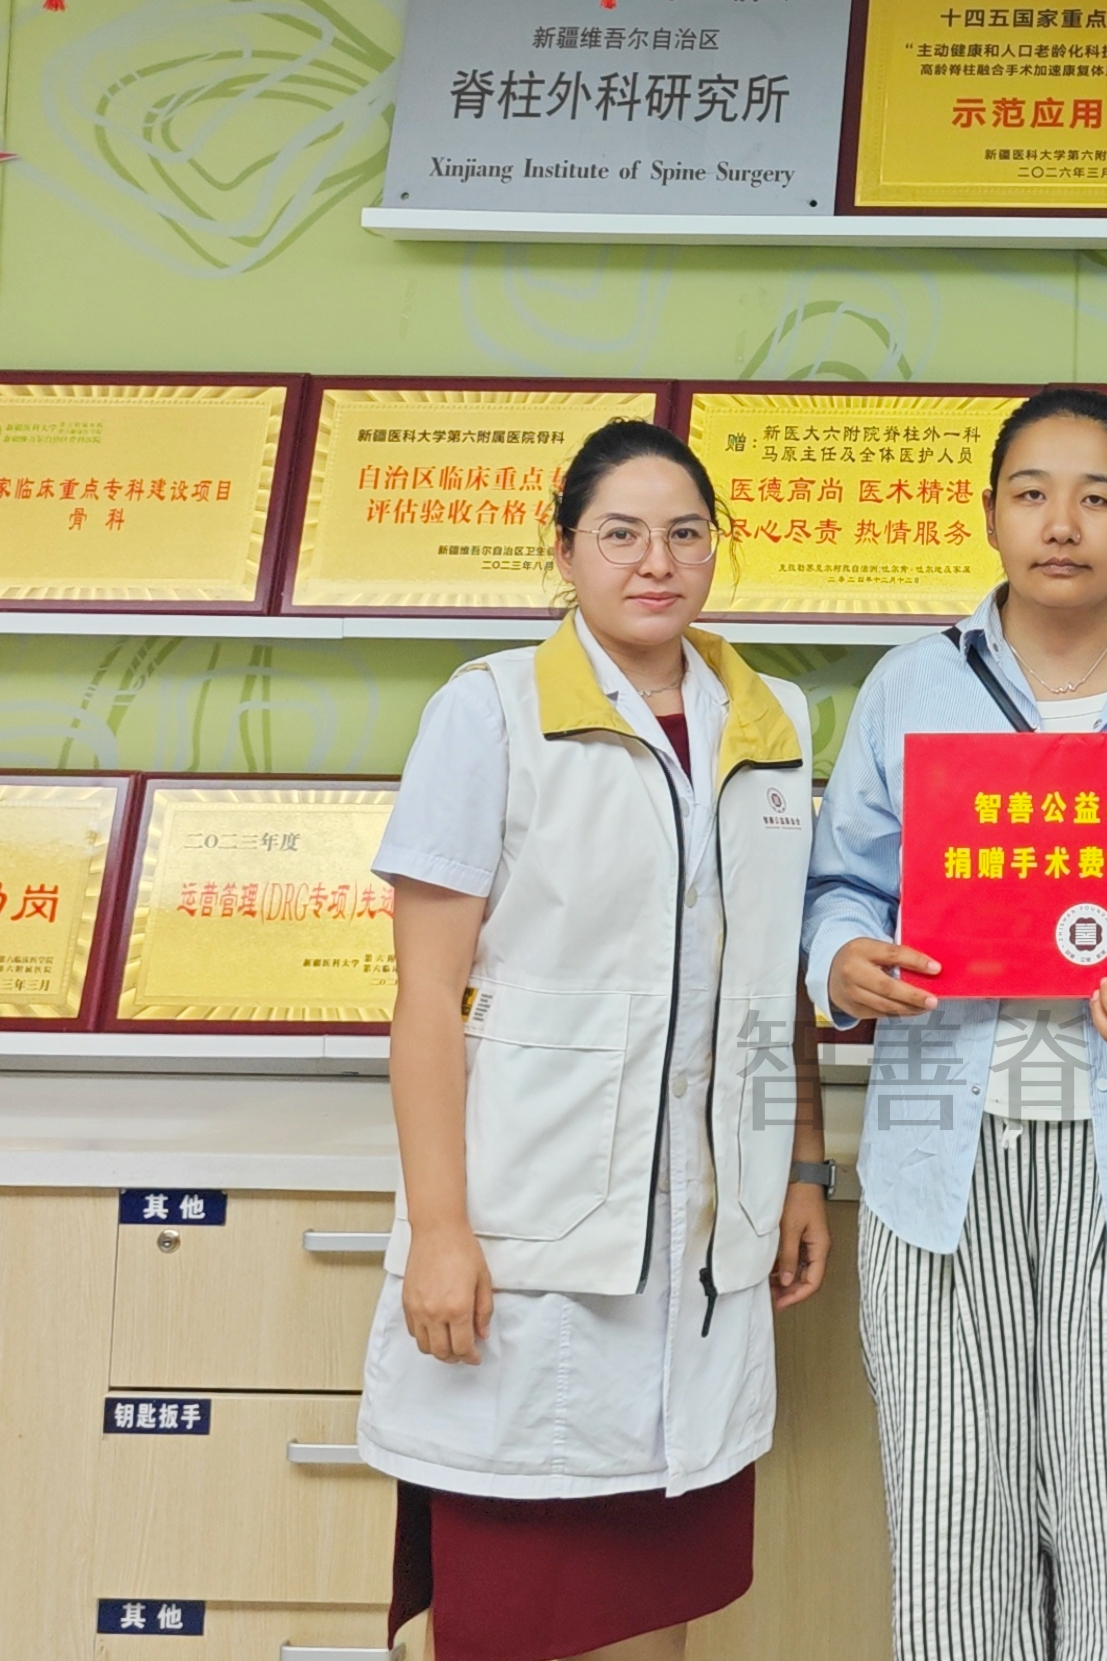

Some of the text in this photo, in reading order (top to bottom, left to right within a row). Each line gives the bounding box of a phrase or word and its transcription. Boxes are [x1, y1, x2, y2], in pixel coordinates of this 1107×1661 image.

[532, 26, 720, 51] 新疆维吾尔自治区
[450, 69, 790, 124] 脊柱外科研究所
[429, 156, 796, 188] Xinjiang Institute of Spine Surgery
[357, 429, 565, 444] 新疆医科大学第六附属医院骨科
[763, 425, 981, 443] 新医大六附院脊柱外一科
[762, 445, 973, 464] 马原主任及全体医护人员
[730, 477, 974, 504] 医德高尚 医术精湛
[724, 518, 972, 546] 尽心尽责 热情服务
[0, 882, 59, 923] 岗
[143, 1194, 206, 1221] 其他
[114, 1403, 201, 1430] 钥匙扳手
[120, 1603, 183, 1630] 其他
